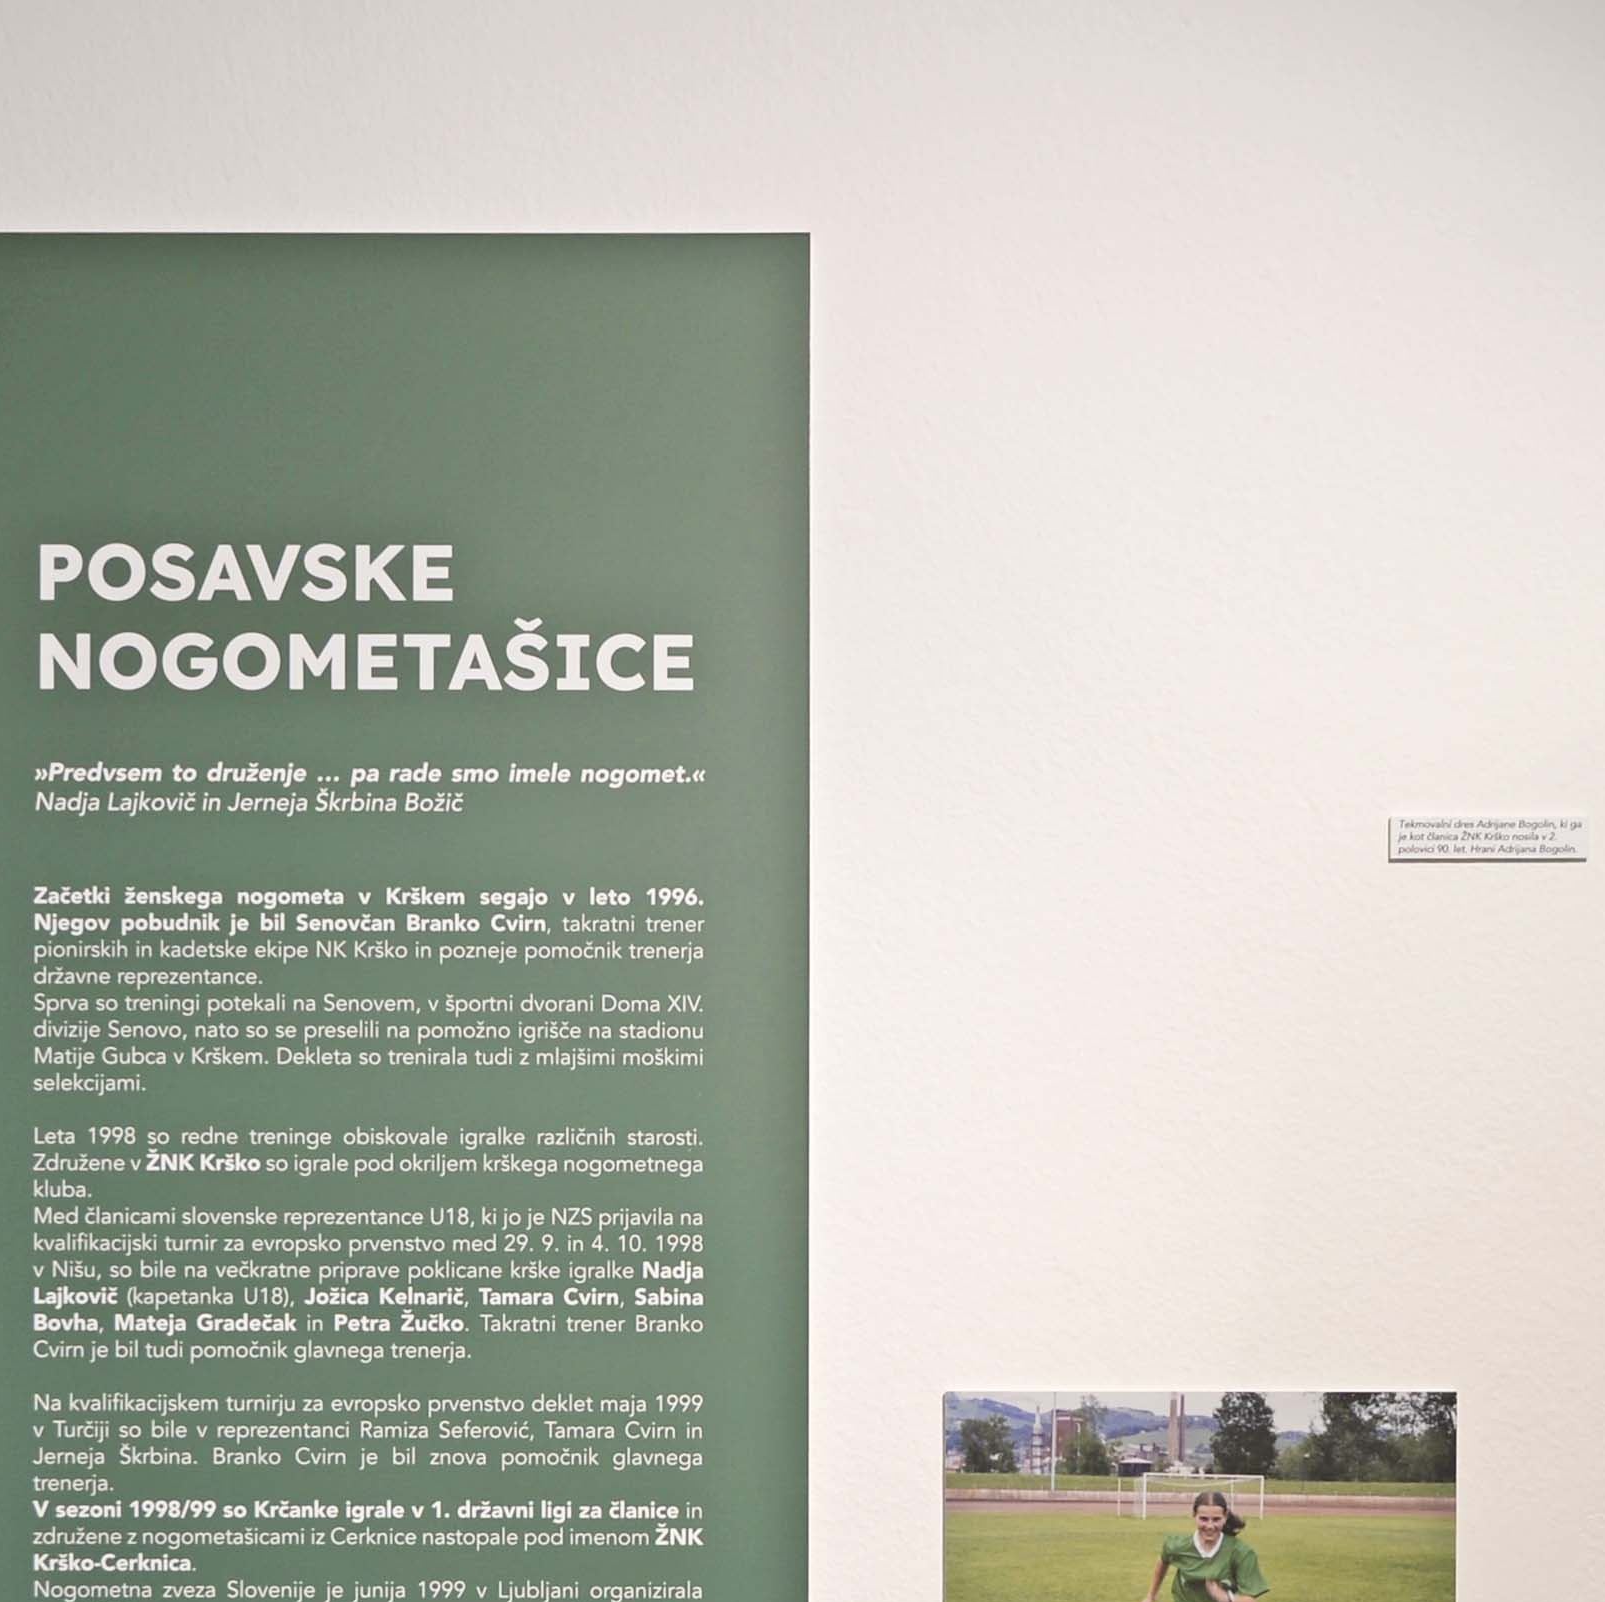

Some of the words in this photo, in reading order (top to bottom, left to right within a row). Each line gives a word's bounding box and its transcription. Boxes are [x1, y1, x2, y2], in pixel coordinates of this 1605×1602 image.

[39, 542, 454, 602] POSAVSKE
[39, 617, 695, 692] NOGOMETAŠICE
[171, 764, 198, 783] to
[206, 761, 308, 788] druženje
[350, 767, 380, 788] pa
[388, 761, 442, 783] rade
[450, 767, 500, 783] smo
[508, 761, 572, 784] imele
[35, 790, 101, 817] Nadja
[107, 790, 196, 817] Lajkovič
[202, 791, 221, 812] in
[226, 791, 309, 818] Jerneja
[314, 788, 397, 812] Škrbina
[404, 791, 464, 813] Božič
[33, 885, 111, 905] Začetki
[124, 885, 223, 910] ženskega
[237, 888, 345, 910] nogometa
[357, 891, 372, 905] v
[386, 885, 466, 906] Krškem
[479, 886, 549, 911] segajo
[562, 892, 576, 906] v
[589, 886, 631, 906] leto
[645, 887, 705, 907] 1996.
[34, 1126, 76, 1145] Leta
[88, 1126, 136, 1145] 1998
[147, 1131, 170, 1146] so
[181, 1125, 239, 1145] redne
[248, 1127, 332, 1151] treninge
[342, 1125, 449, 1146] obiskovale
[459, 1125, 526, 1151] igralke
[536, 1125, 616, 1146] različnih
[626, 1127, 704, 1147] starosti.
[33, 1552, 197, 1572] Krško-Cerknica.
